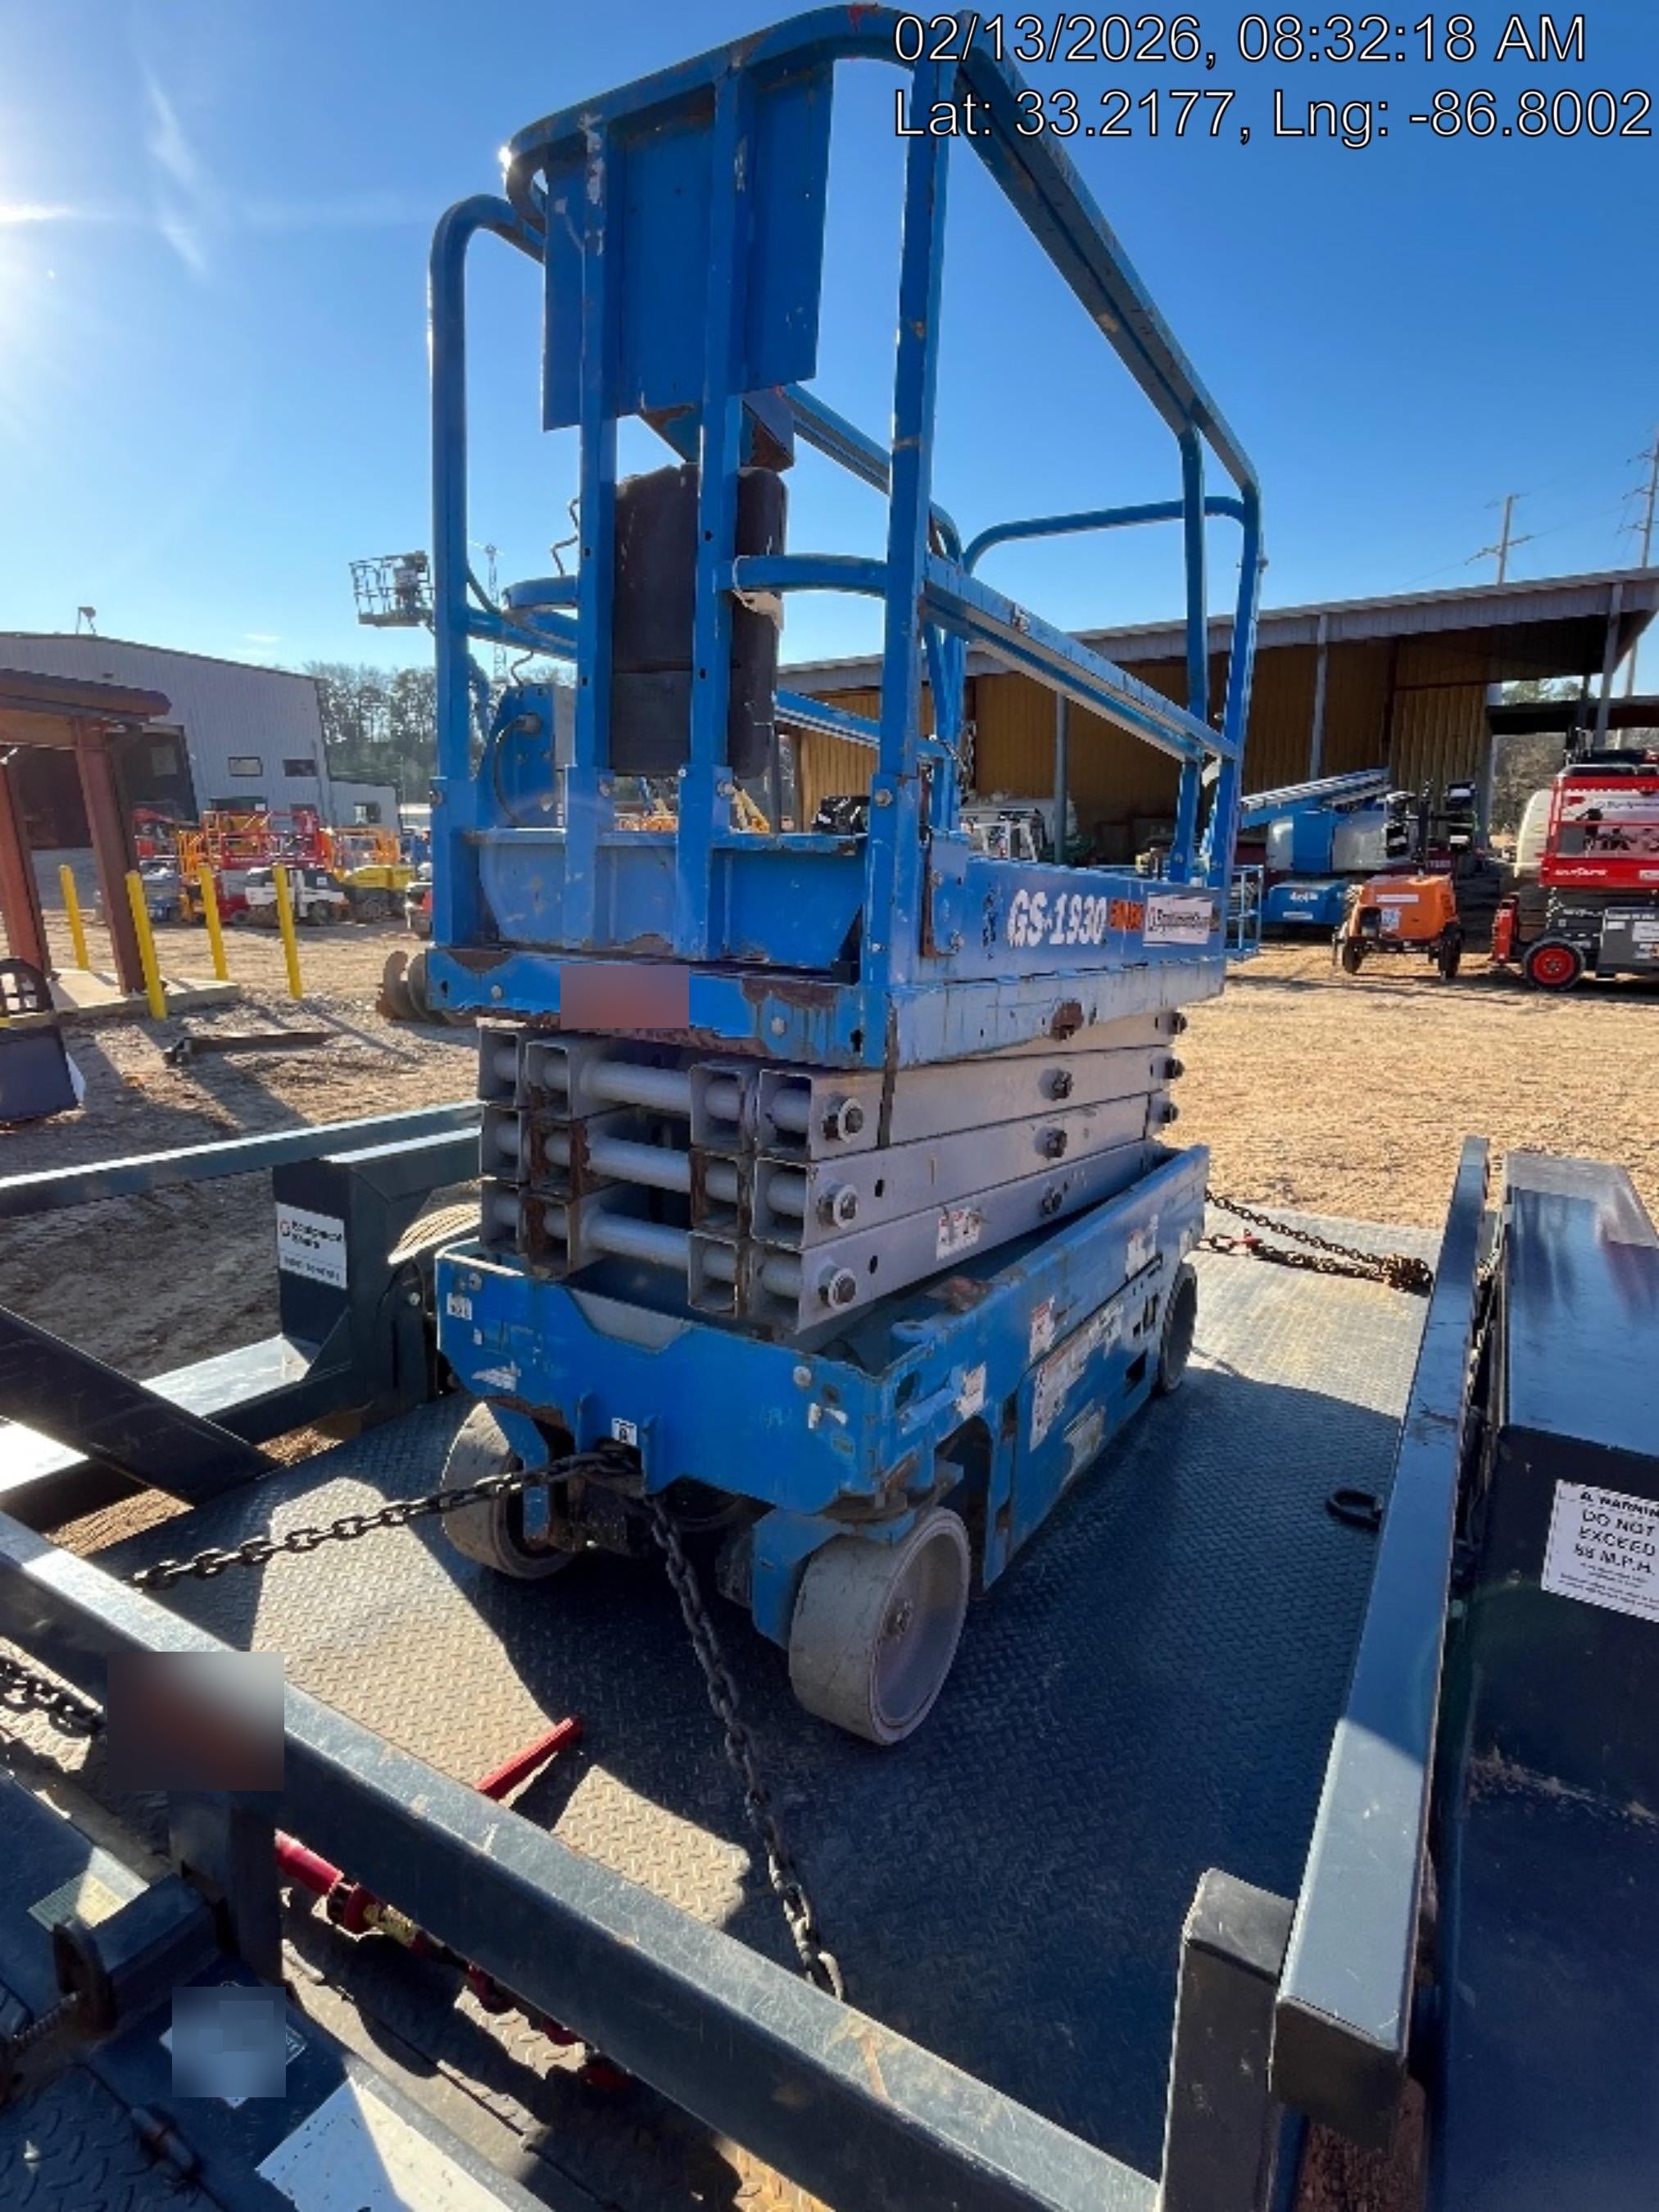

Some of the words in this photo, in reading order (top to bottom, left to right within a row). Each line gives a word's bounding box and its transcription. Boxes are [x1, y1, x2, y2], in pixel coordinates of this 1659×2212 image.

[1007, 889, 1107, 947] GS-1930
[1599, 1497, 1659, 1518] WARNIN
[1583, 1509, 1611, 1527] DO
[1616, 1518, 1655, 1537] NOT
[1580, 1525, 1655, 1557] EXCEED
